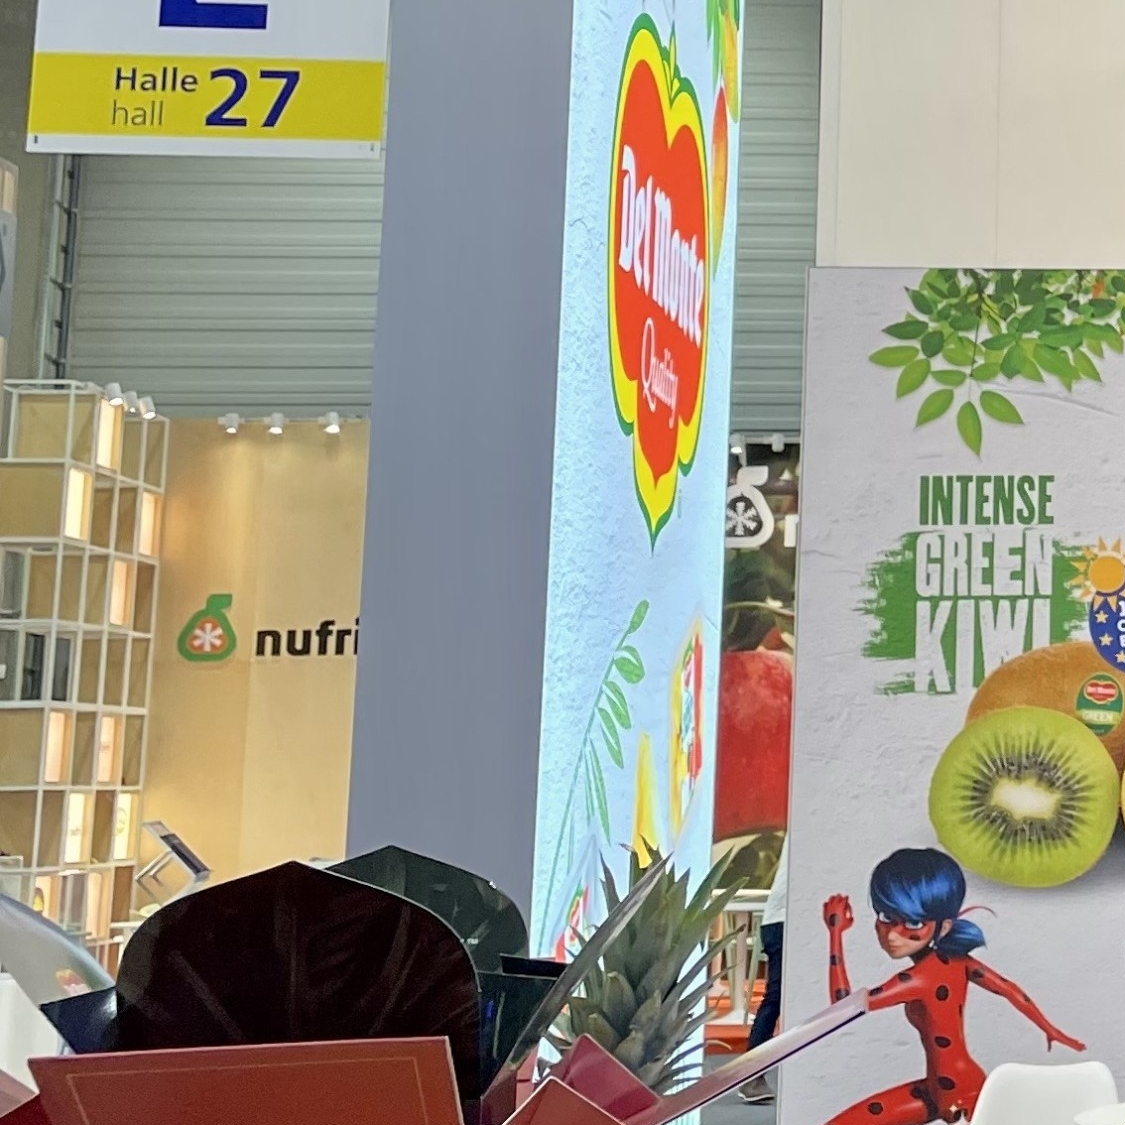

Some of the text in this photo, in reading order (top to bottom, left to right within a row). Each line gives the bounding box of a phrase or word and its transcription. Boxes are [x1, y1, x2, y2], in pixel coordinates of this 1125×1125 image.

[111, 100, 164, 126] hall
[113, 67, 301, 129] Halle 27
[618, 144, 705, 349] Del Monte
[641, 317, 679, 430] Quality
[919, 475, 1056, 526] INTENSE
[915, 527, 1054, 598] GREEN
